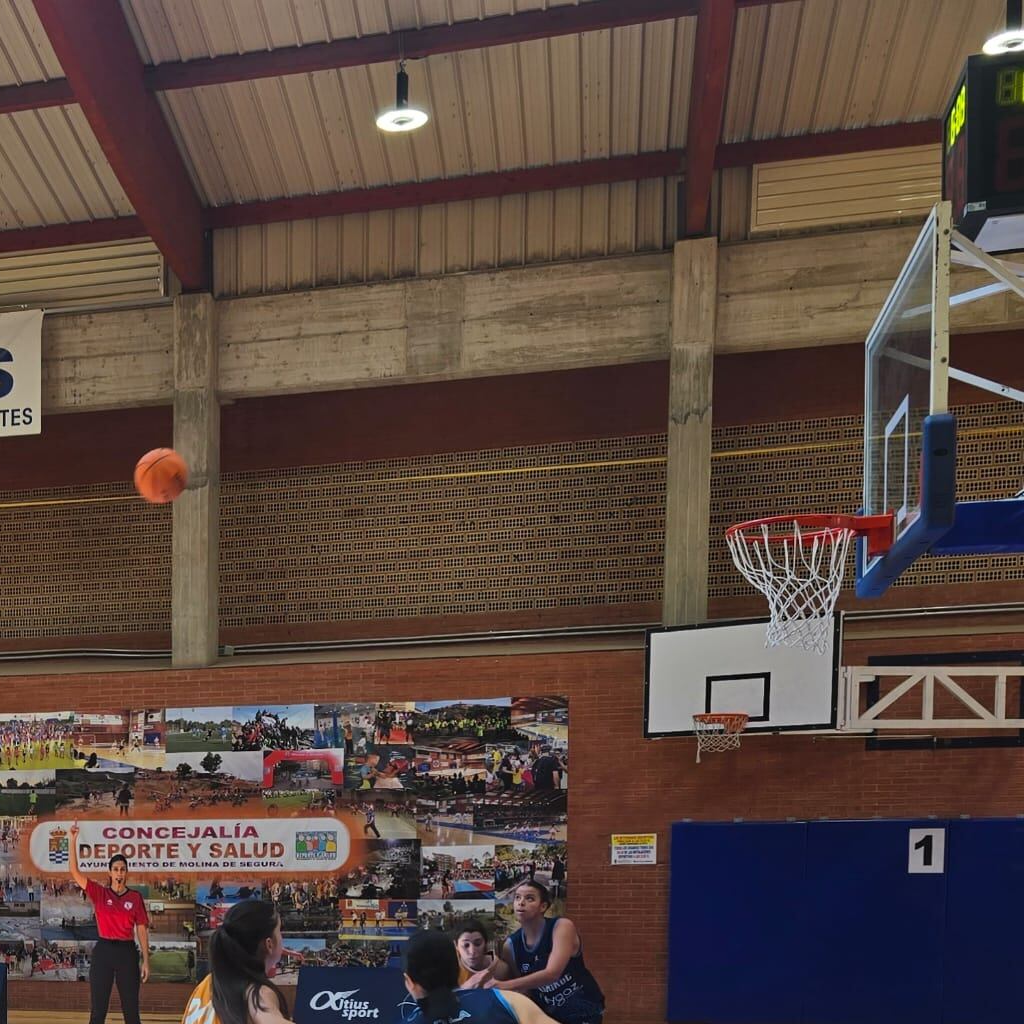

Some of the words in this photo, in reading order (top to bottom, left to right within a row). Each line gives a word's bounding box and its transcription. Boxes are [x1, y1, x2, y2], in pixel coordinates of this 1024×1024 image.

[102, 823, 260, 839] CONCEJALÍA
[79, 842, 180, 859] DEPORTE
[187, 842, 202, 858] Y
[209, 842, 285, 858] SALUD
[914, 835, 934, 866] 1
[341, 1008, 380, 1021] sport
